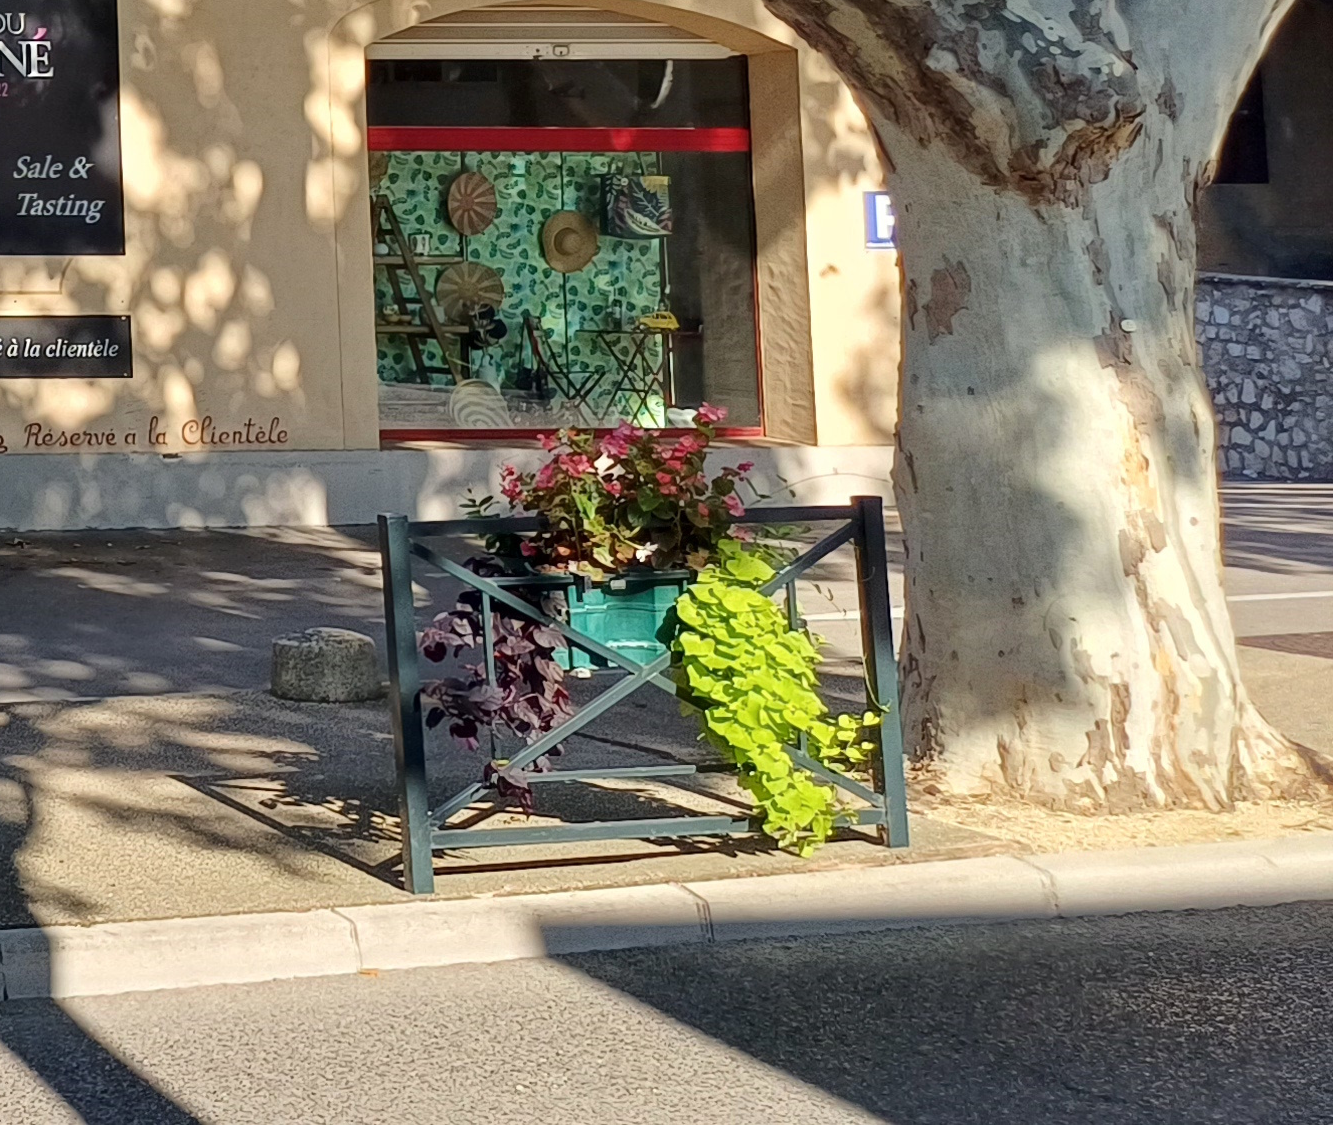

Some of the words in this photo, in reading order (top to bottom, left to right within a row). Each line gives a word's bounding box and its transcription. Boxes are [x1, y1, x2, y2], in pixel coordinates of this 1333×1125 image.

[12, 155, 64, 179] Sale
[68, 156, 94, 179] &
[16, 193, 106, 224] Tasting
[6, 338, 19, 358] à
[23, 338, 41, 358] la
[45, 338, 119, 358] clientèle
[24, 422, 116, 447] Réservé
[148, 415, 169, 446] la
[181, 415, 289, 446] Clientèle
